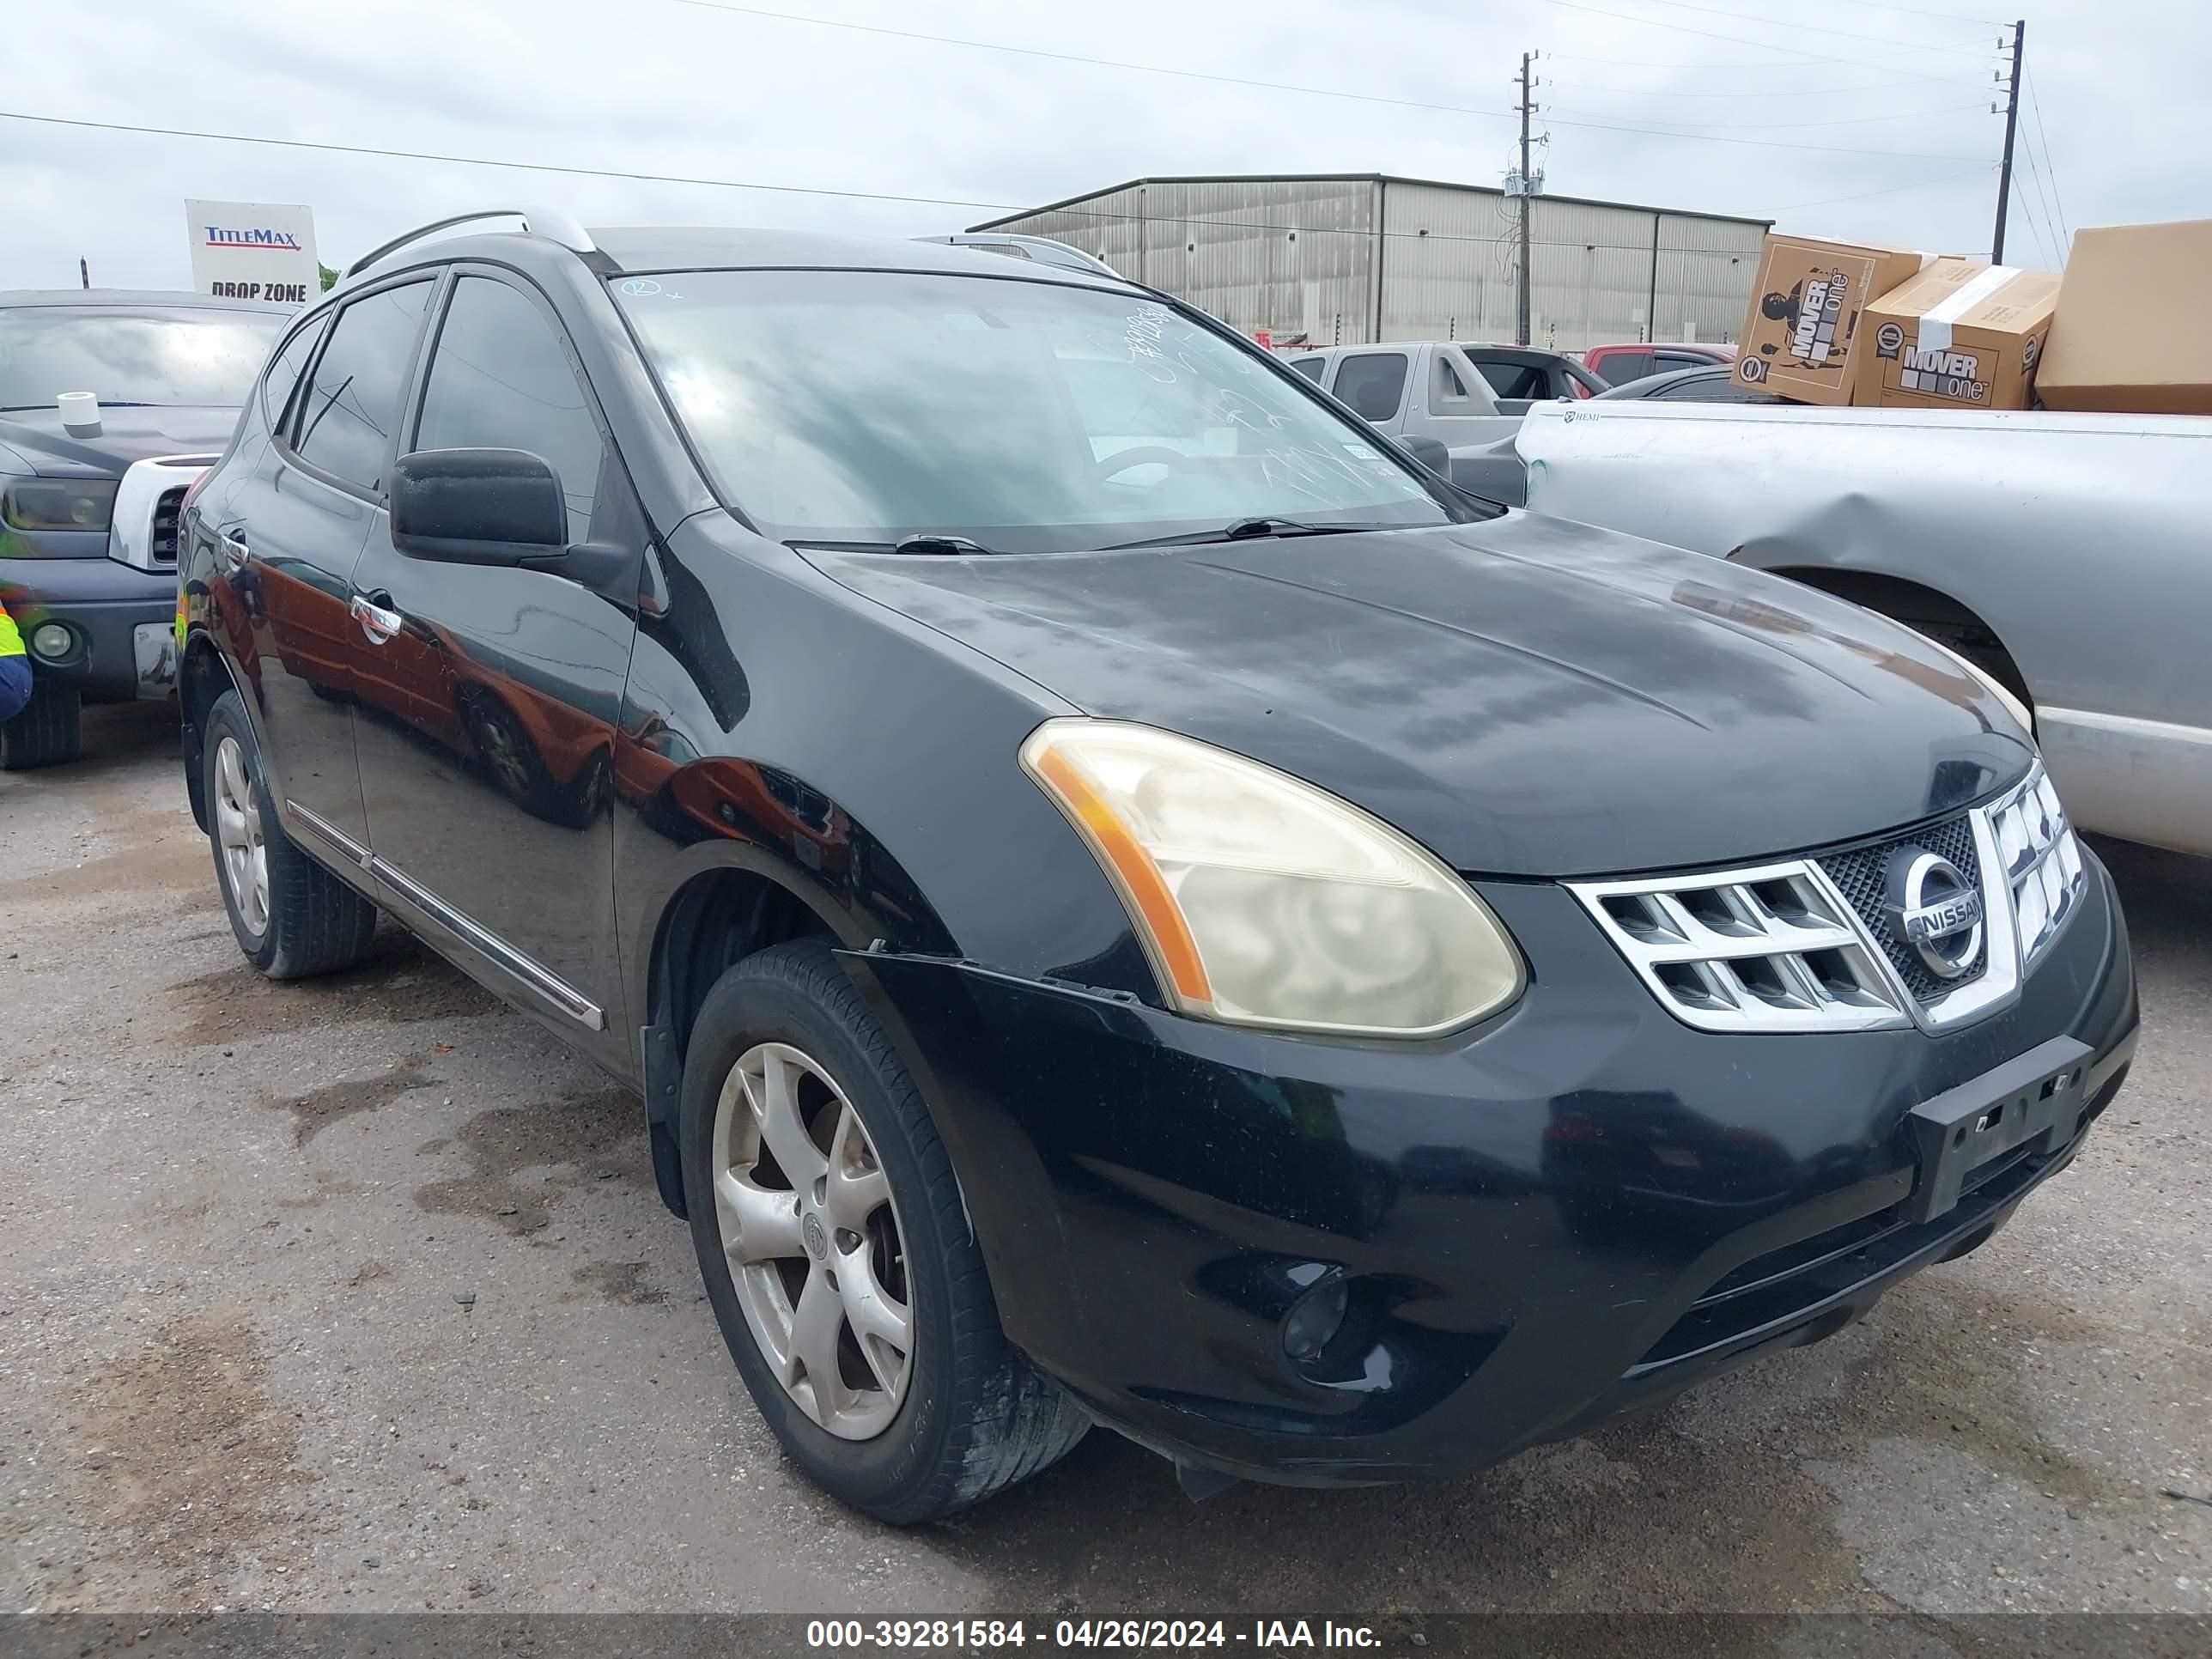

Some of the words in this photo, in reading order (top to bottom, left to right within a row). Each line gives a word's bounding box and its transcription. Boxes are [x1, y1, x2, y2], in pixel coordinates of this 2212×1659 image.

[212, 282, 260, 299] DROP
[264, 283, 307, 302] ZONE
[1825, 273, 1849, 312] one
[1790, 279, 1829, 359] MOVER
[1903, 345, 1978, 380] MOVER
[1948, 378, 1984, 400] one
[1574, 412, 1601, 422] HEMI
[1922, 899, 1981, 933] NISSAN
